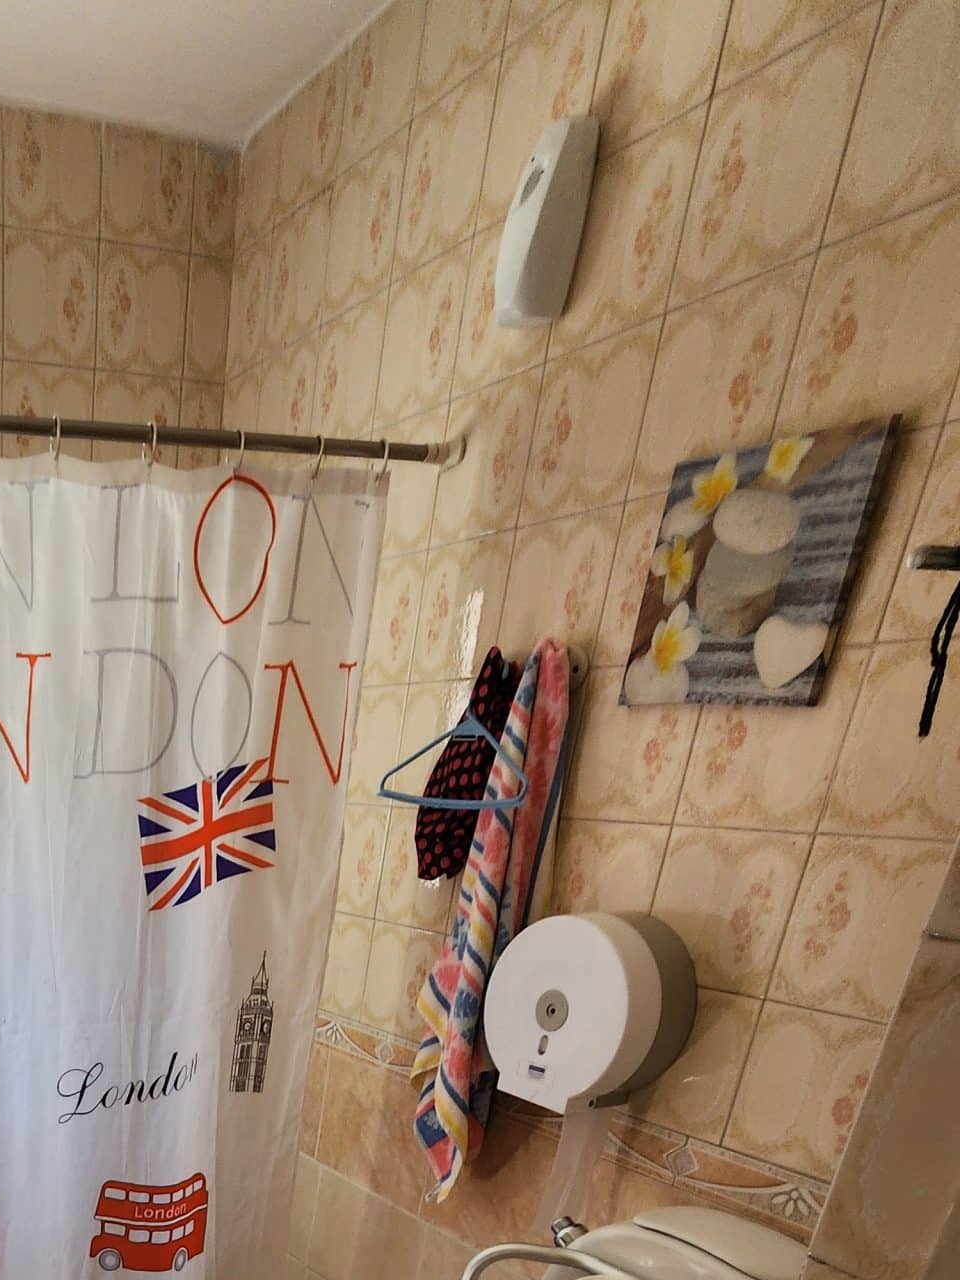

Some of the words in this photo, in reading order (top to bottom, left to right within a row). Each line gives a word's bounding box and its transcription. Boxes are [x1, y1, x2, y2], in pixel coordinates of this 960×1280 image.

[74, 647, 357, 787] DON
[57, 1052, 199, 1125] London
[134, 1202, 188, 1220] London
